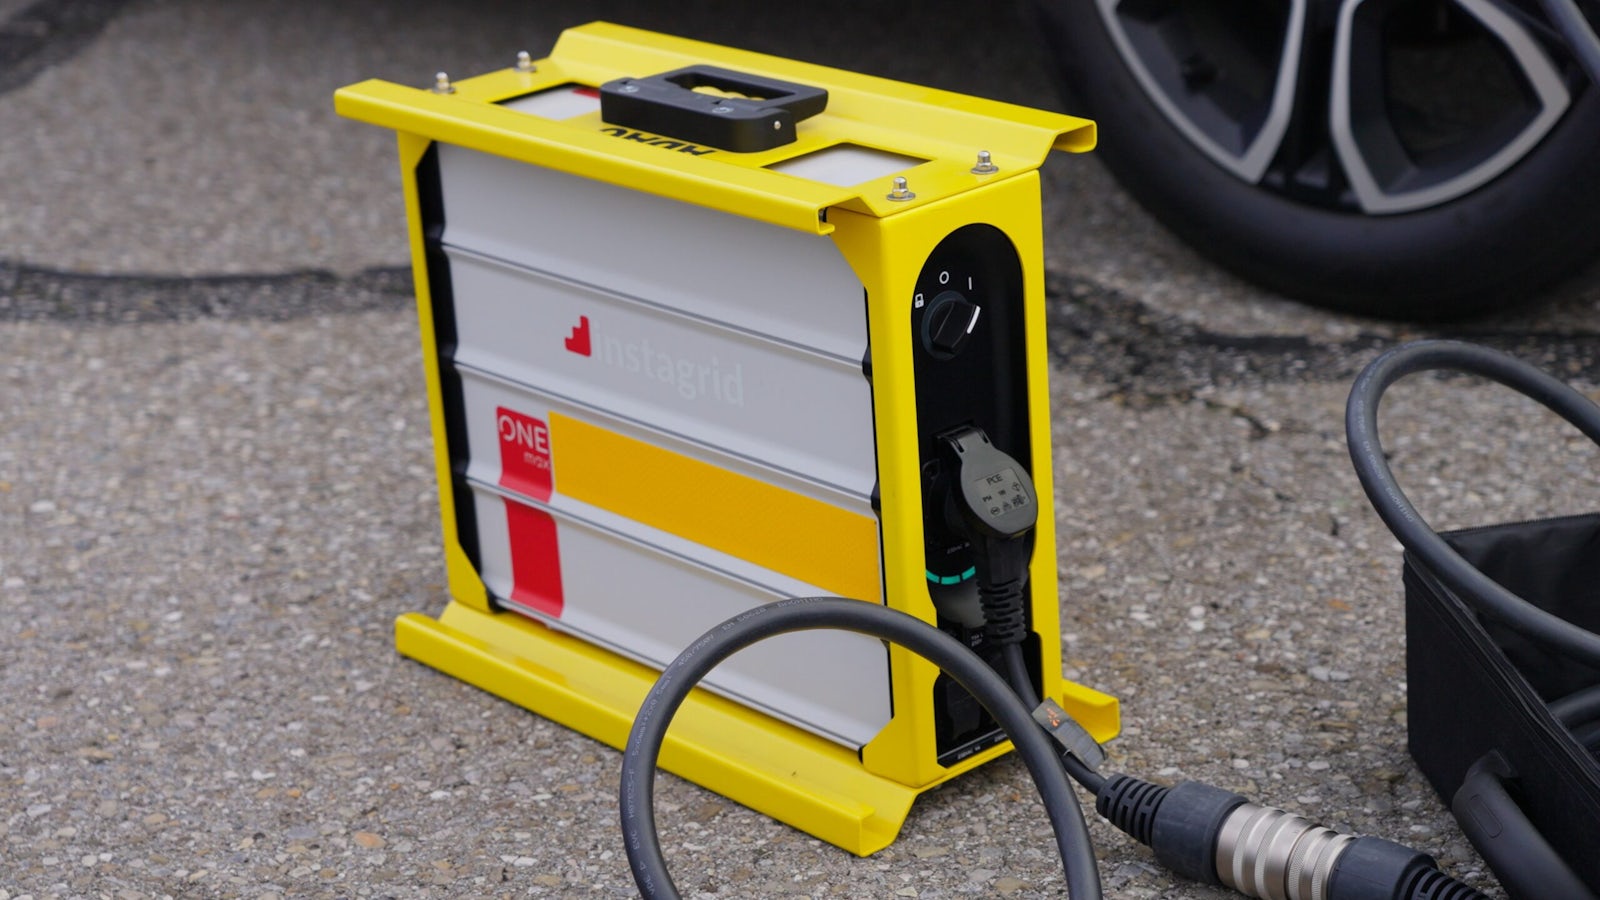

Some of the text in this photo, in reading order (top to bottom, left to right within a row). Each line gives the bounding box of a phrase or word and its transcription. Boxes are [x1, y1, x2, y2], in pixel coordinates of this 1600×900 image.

[593, 322, 745, 407] instagrid
[499, 415, 549, 454] ONE
[986, 474, 1003, 486] PCE
